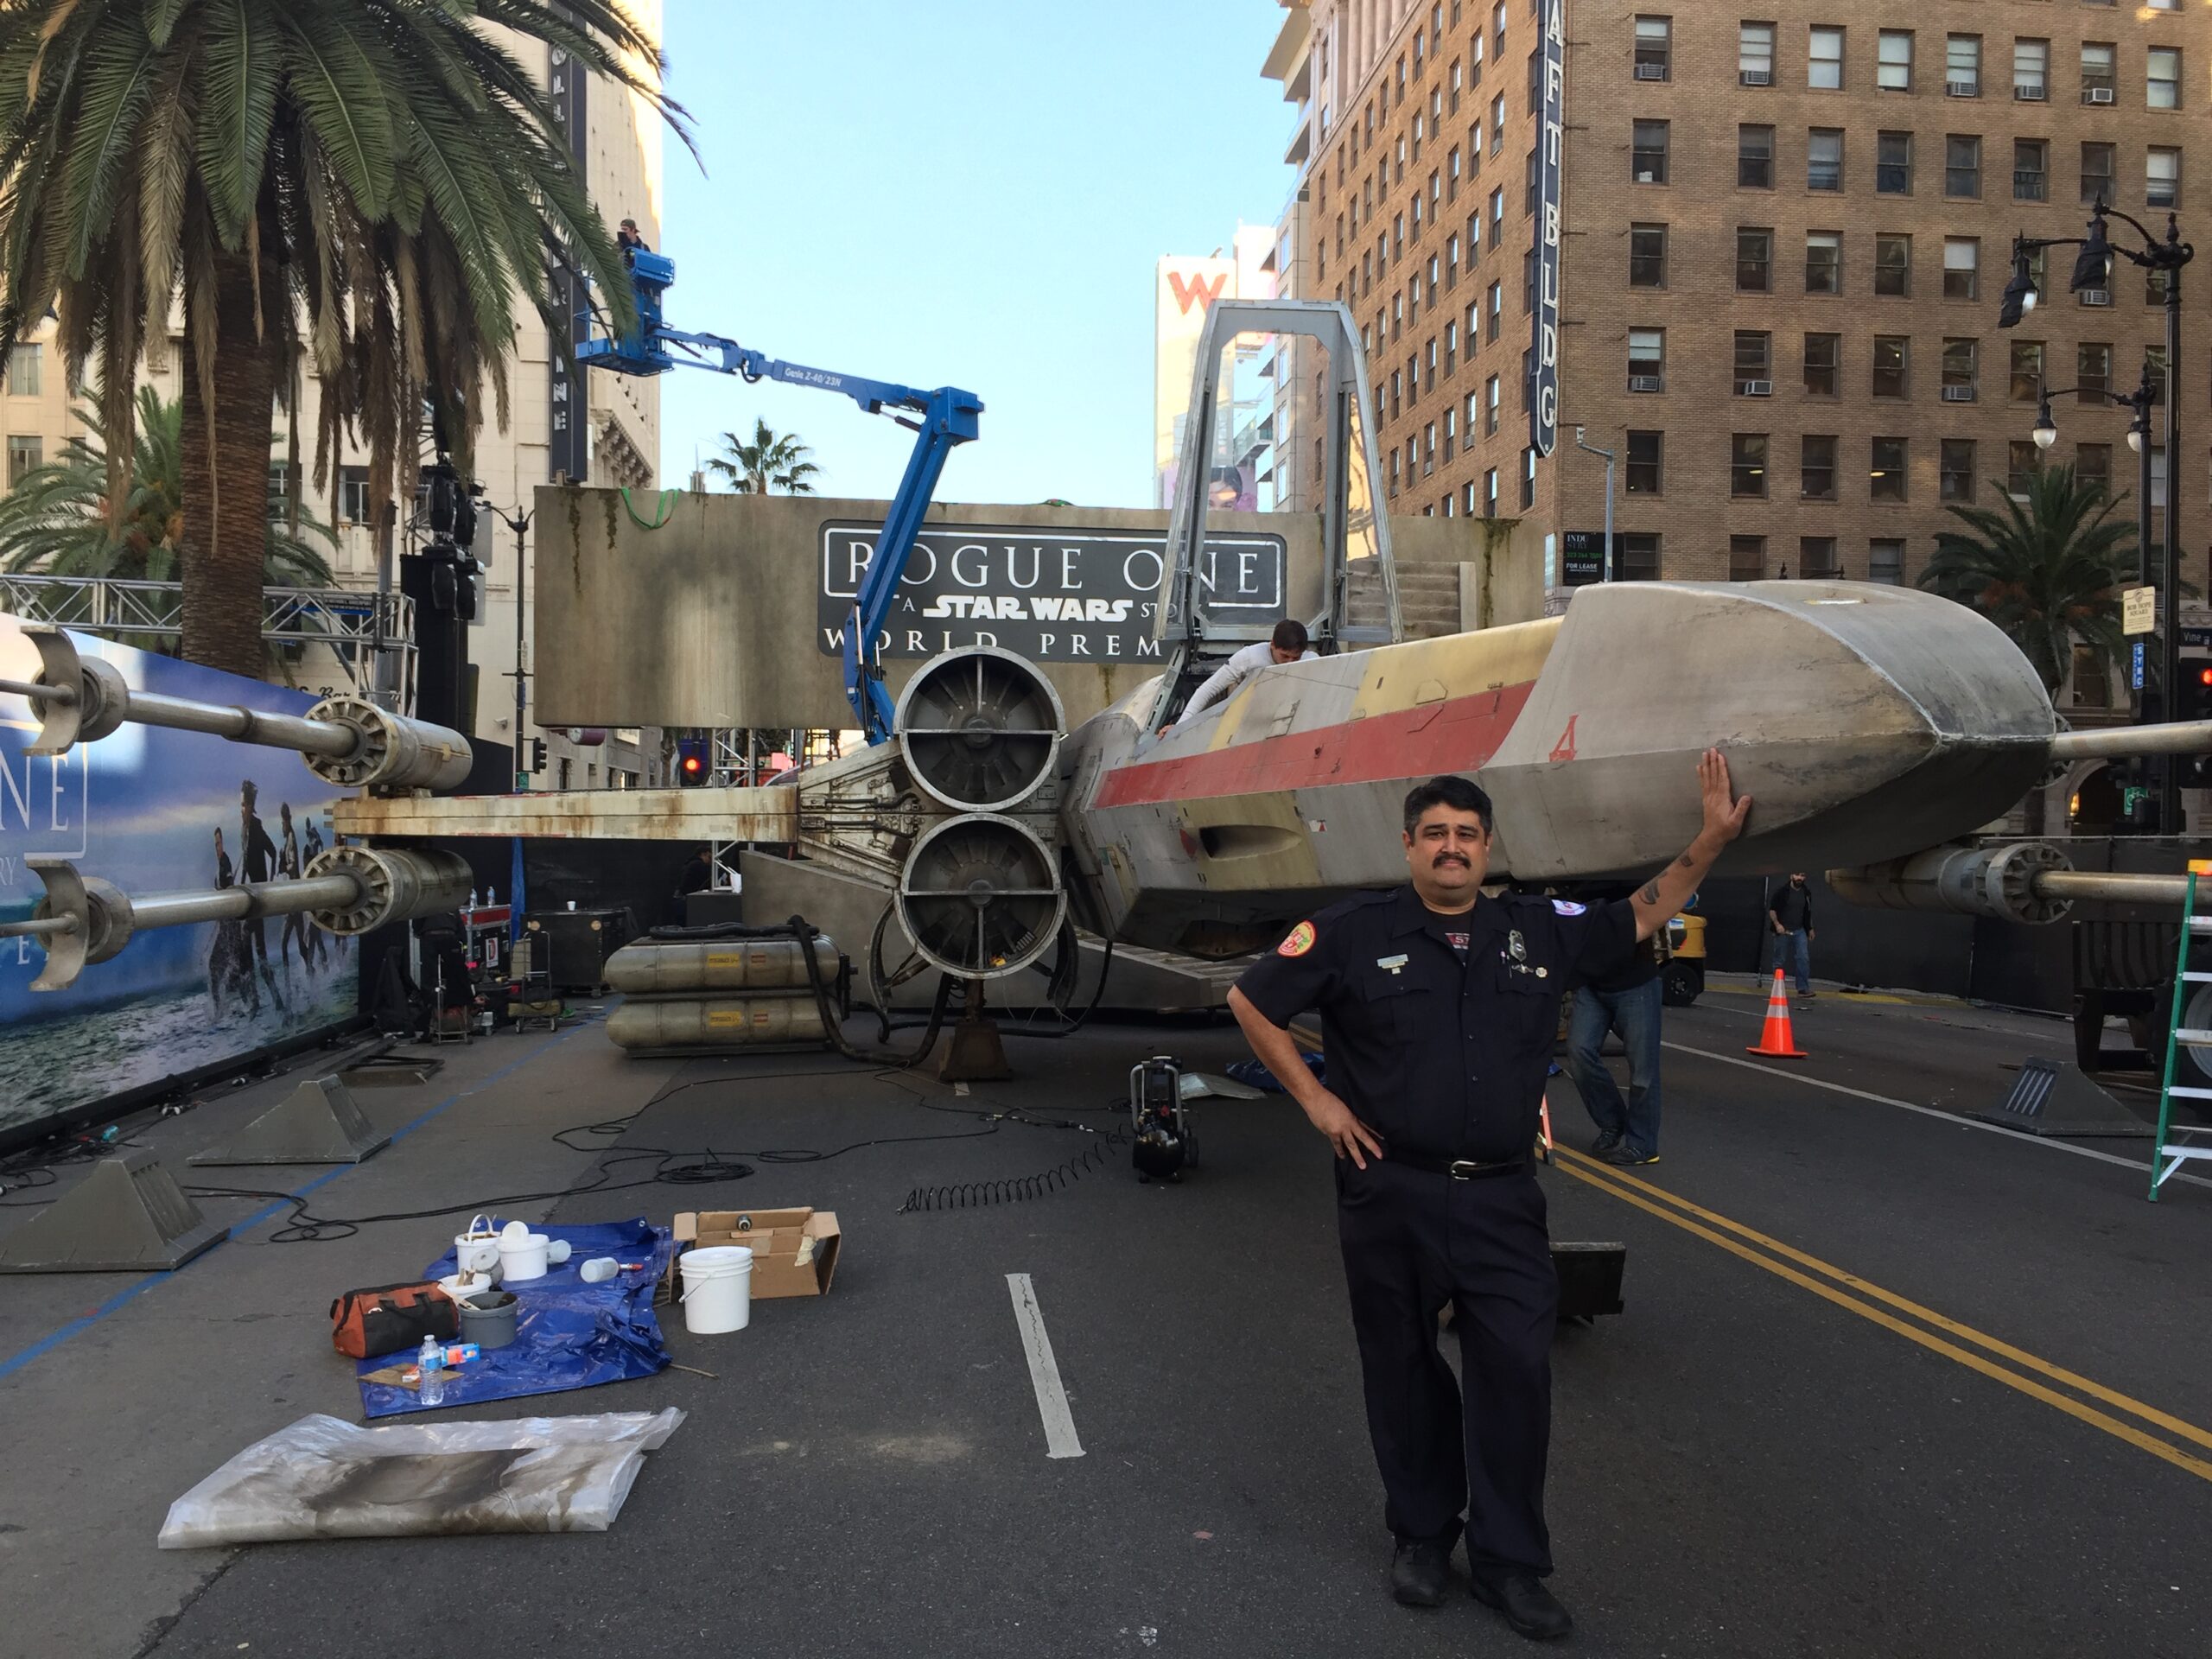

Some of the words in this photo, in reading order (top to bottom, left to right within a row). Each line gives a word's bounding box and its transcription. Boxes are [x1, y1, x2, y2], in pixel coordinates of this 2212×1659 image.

[1167, 271, 1228, 316] W
[1541, 202, 1558, 428] BLDG
[785, 367, 804, 379] Genie
[804, 372, 842, 387] Z-40/23N
[901, 597, 916, 613] A
[923, 594, 1028, 620] STAR
[1030, 597, 1134, 623] WARS
[2183, 632, 2201, 642] Vine
